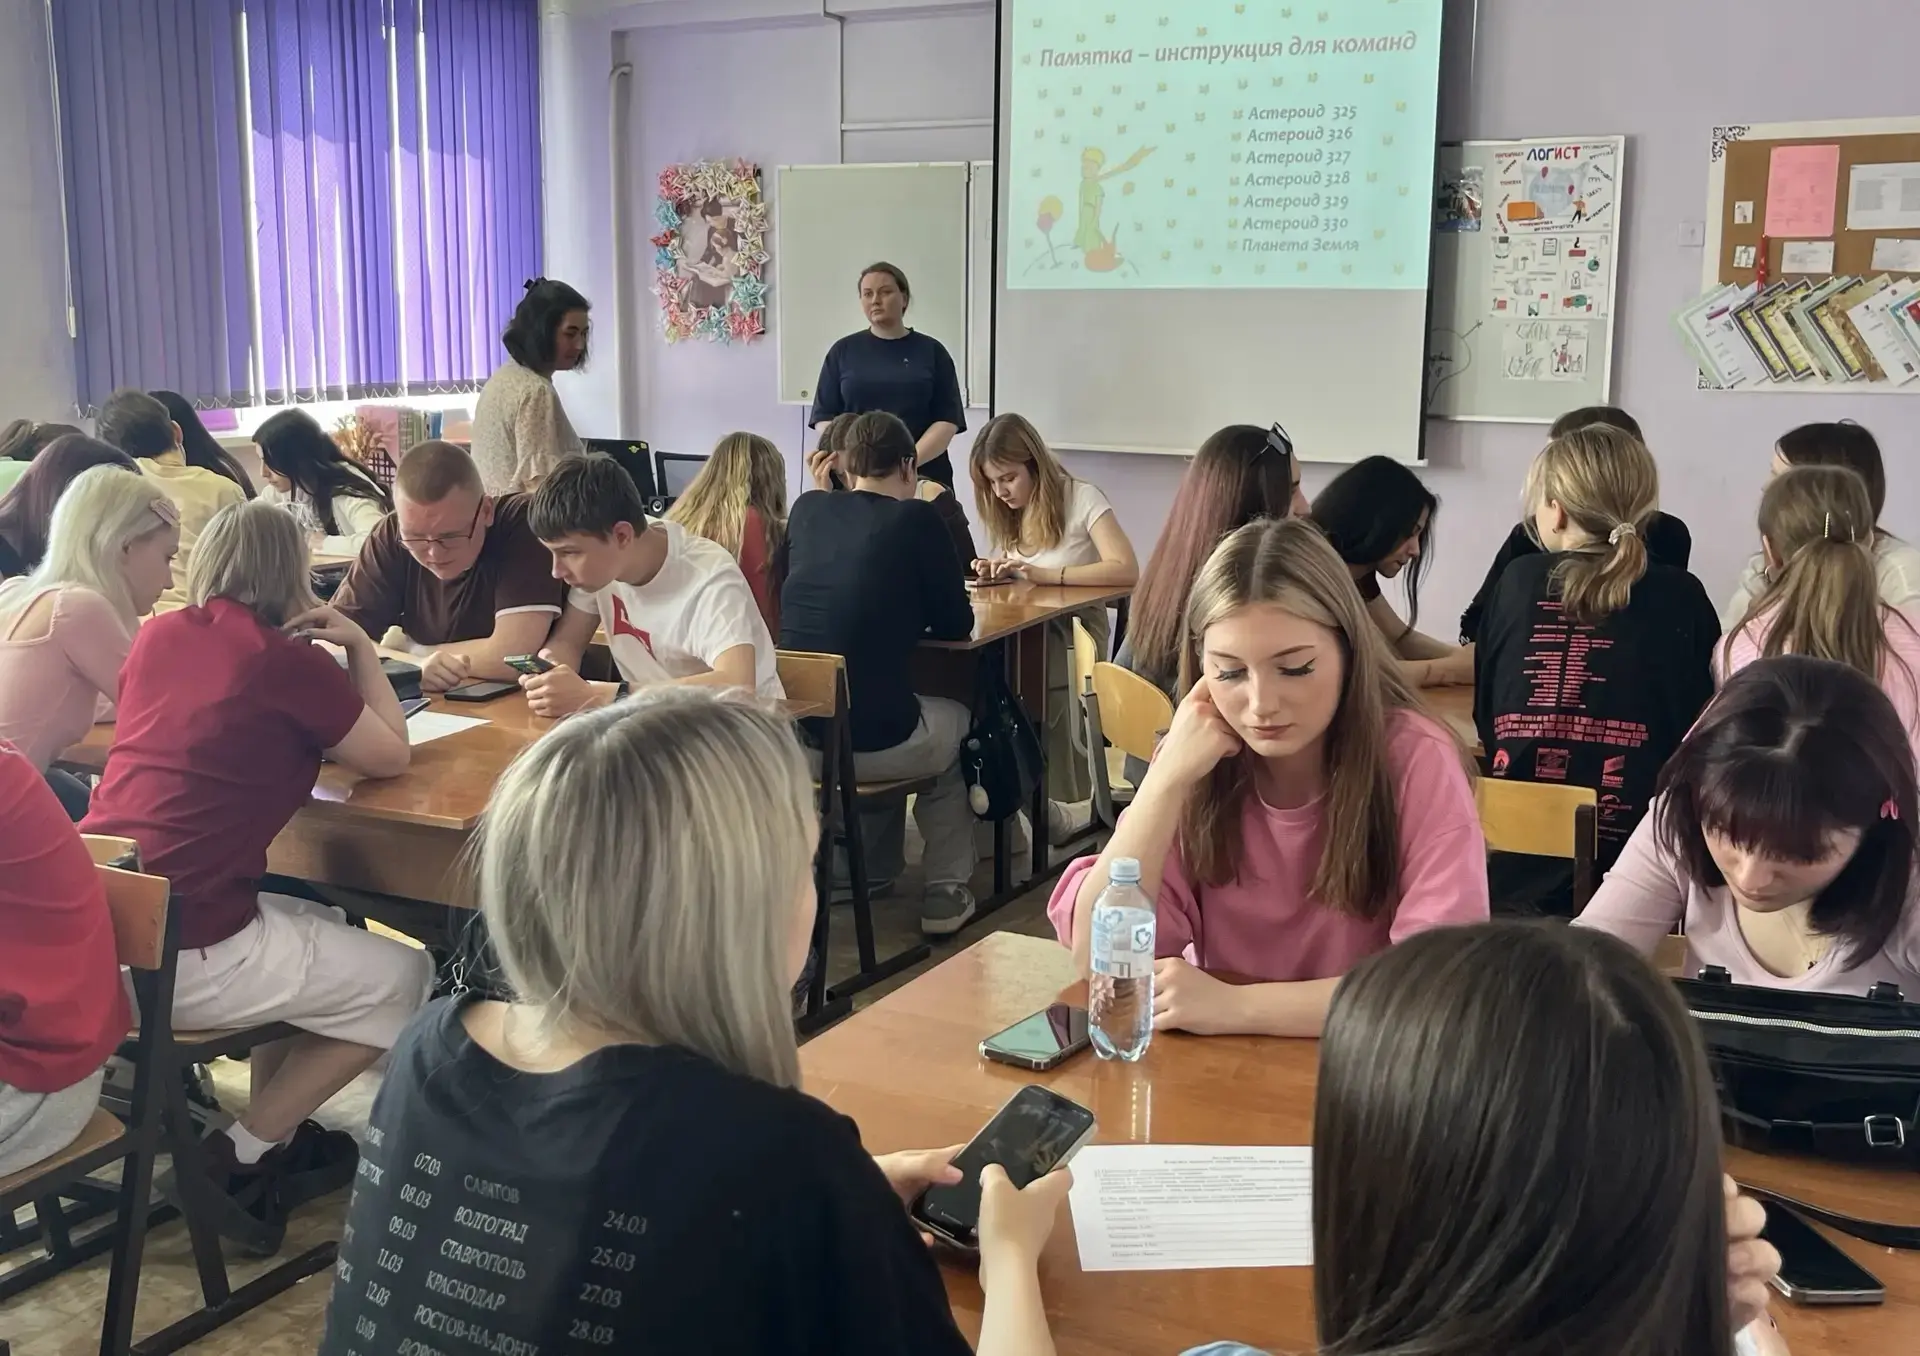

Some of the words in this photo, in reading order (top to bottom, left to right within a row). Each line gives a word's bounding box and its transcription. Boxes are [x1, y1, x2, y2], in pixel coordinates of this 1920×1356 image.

[1040, 48, 1133, 68] Памятка
[1155, 37, 1283, 65] инструкция
[1288, 34, 1327, 56] для
[1332, 31, 1418, 53] команд
[1248, 104, 1325, 122] Астероид
[1332, 105, 1357, 121] 325
[1247, 126, 1323, 144] Астероид
[1327, 127, 1353, 142] 326
[1246, 148, 1322, 166] Астероид
[1327, 150, 1351, 167] 327
[1526, 146, 1582, 161] ЛОГИСТ
[1245, 171, 1321, 188] Астероид
[1325, 171, 1350, 186] 328
[1244, 193, 1321, 211] Астероид
[1322, 195, 1348, 211] 329
[1243, 215, 1320, 233] Астероид
[1322, 217, 1348, 232] 330
[1242, 238, 1309, 252] Планета
[1313, 238, 1359, 252] Земля
[414, 1153, 441, 1176] 07.03
[400, 1184, 432, 1209] 08.03
[464, 1174, 520, 1203] САРАТОВ
[603, 1210, 647, 1234] 24.03
[389, 1215, 417, 1240] 09.03
[454, 1206, 529, 1244] ВОЛГОГРАД
[591, 1246, 636, 1271] 25.03
[377, 1248, 403, 1273] 11.03
[441, 1238, 526, 1279] СТАВРОПОЛЬ
[579, 1283, 622, 1308] 27.03
[366, 1281, 391, 1307] 12.03
[425, 1270, 506, 1311] КРАСНОДАР
[568, 1318, 614, 1344] 28.03
[414, 1304, 539, 1356] РОСТОВ-НА-ДОНУ
